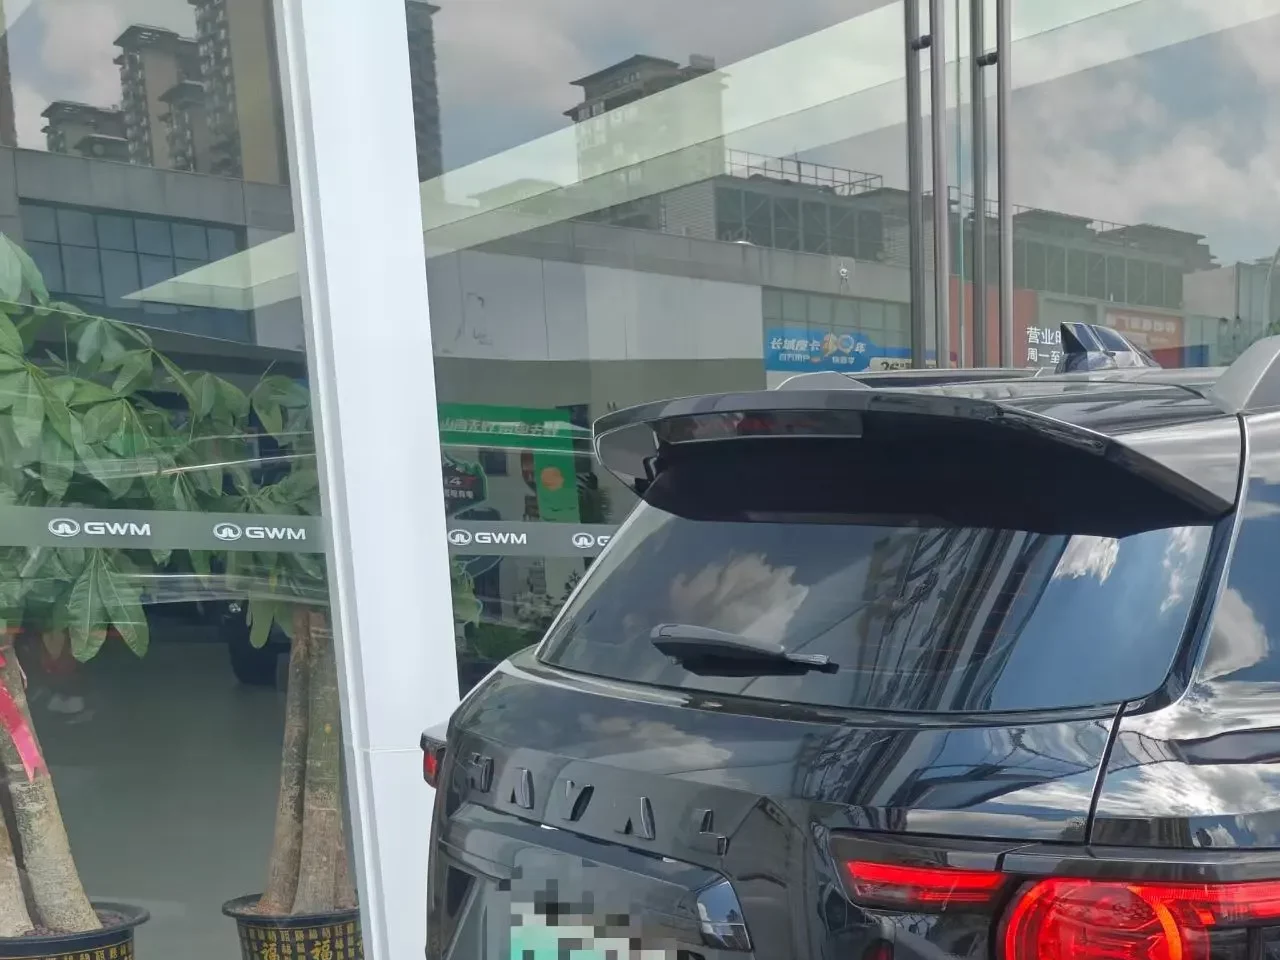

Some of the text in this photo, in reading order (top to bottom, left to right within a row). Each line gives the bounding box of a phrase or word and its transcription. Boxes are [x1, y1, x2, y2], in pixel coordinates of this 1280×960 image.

[1026, 326, 1061, 345] 营业
[1027, 347, 1064, 364] 周一至
[84, 522, 151, 536] GWM
[245, 526, 306, 540] GWM
[474, 532, 527, 545] GWM
